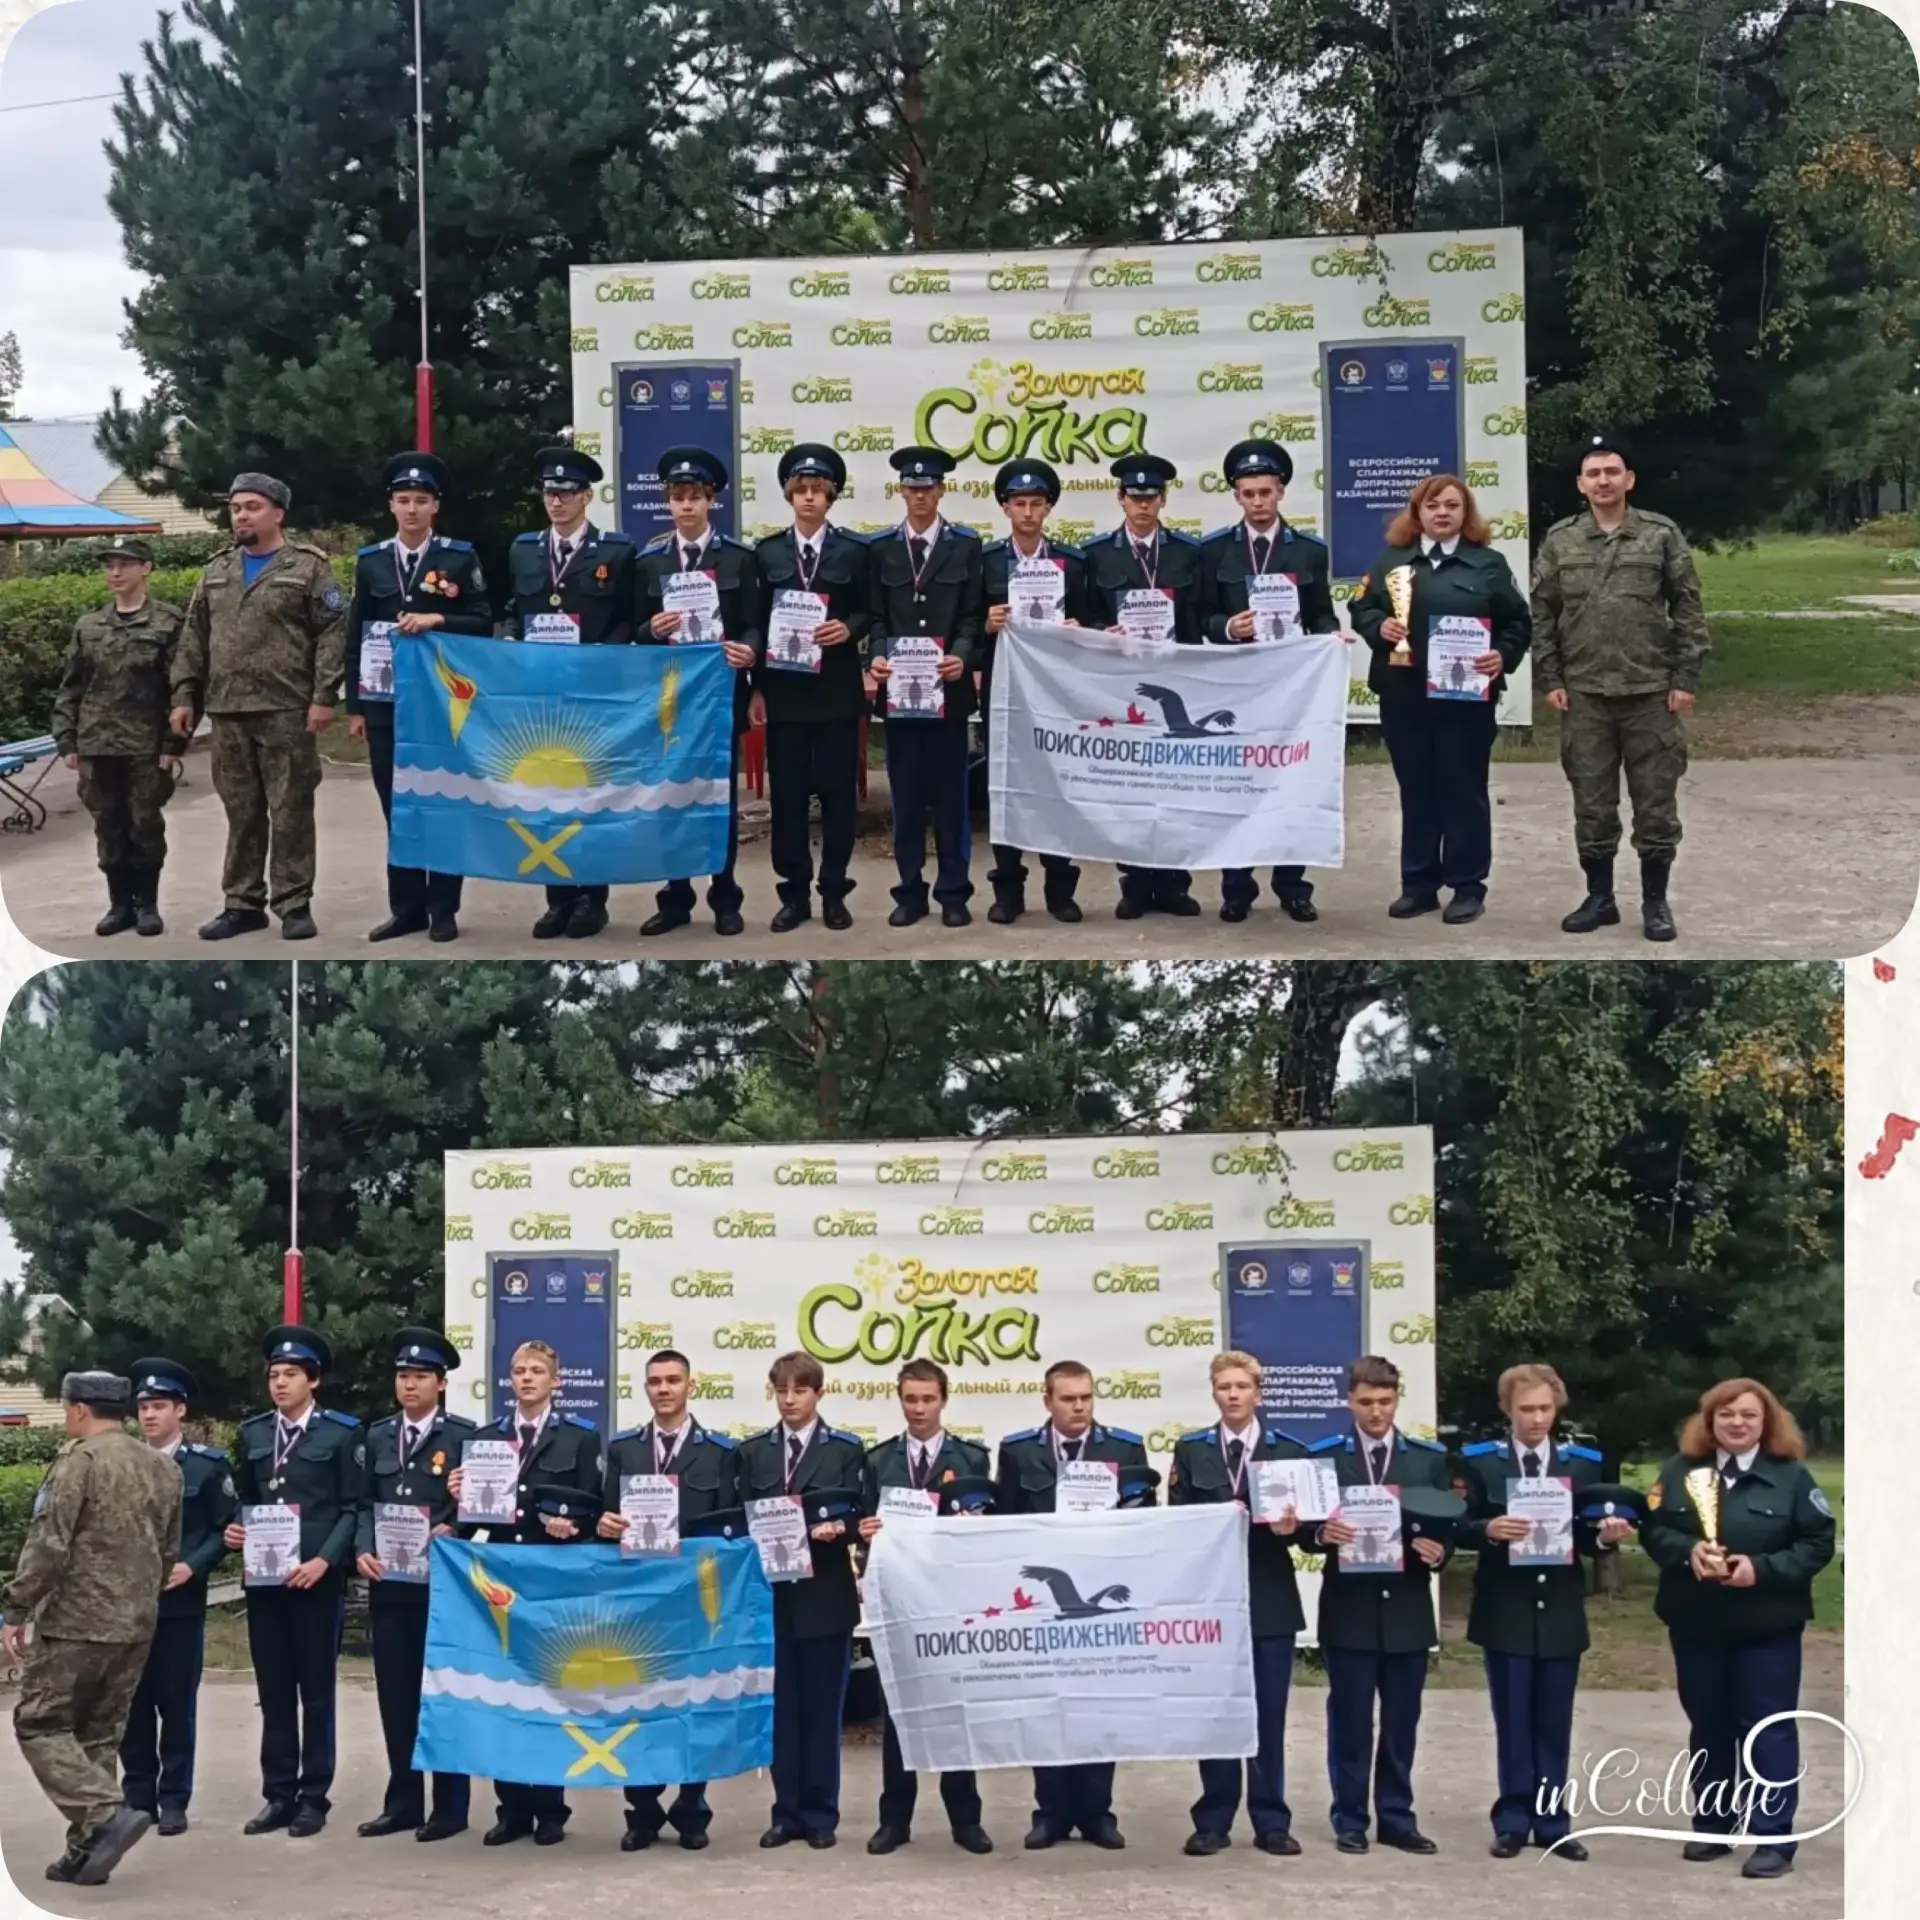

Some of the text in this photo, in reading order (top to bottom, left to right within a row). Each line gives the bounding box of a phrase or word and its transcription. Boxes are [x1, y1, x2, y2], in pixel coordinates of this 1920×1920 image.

[1196, 260, 1262, 282] Сопка
[1428, 250, 1496, 272] Сопка
[889, 274, 951, 294] Сопка
[987, 270, 1049, 291] Сопка
[1089, 265, 1153, 287] Сопка
[595, 281, 655, 302] Сопка
[691, 279, 751, 300] Сопка
[790, 277, 850, 299] Сопка
[1135, 315, 1199, 337] Сопка
[1248, 310, 1314, 331] Сопка
[1363, 306, 1430, 328] Сопка
[634, 329, 694, 350] Сопка
[732, 327, 792, 348] Сопка
[831, 325, 892, 346] Сопка
[928, 323, 990, 343] Сопка
[1029, 319, 1092, 340] Сопка
[1008, 361, 1145, 406] Золотая
[1197, 370, 1263, 393] Сопка
[791, 382, 852, 404] Сопка
[915, 387, 1147, 464] Сопка
[1250, 420, 1315, 442] Сопка
[833, 431, 894, 452] Сопка
[1349, 457, 1439, 468] ВСЕРОССИЙСКАЯ
[1356, 468, 1432, 478] СПАРТАКИАДА
[1013, 570, 1059, 579] ДИПЛОМ
[666, 582, 712, 593] ДИПЛОМ
[1252, 585, 1293, 594] ДИПЛОМ
[778, 601, 822, 612] ДИПЛОМ
[1122, 600, 1168, 610] ДИПЛОМ
[530, 624, 574, 635] ДИПЛОМ
[1436, 628, 1485, 638] ДИПЛОМ
[892, 649, 939, 657] ДИПЛОМ
[981, 1159, 1047, 1182] Сопка
[1093, 1155, 1159, 1178] Сопка
[1333, 1149, 1403, 1172] Сопка
[471, 1167, 532, 1190] Сопка
[569, 1165, 631, 1188] Сопка
[671, 1165, 733, 1187] Сопка
[774, 1164, 837, 1186] Сопка
[876, 1162, 940, 1184] Сопка
[713, 1217, 776, 1239] Сопка
[814, 1215, 877, 1237] Сопка
[919, 1213, 983, 1235] Сопка
[1028, 1211, 1094, 1233] Сопка
[1145, 1208, 1213, 1231] Сопка
[1264, 1206, 1335, 1228] Сопка
[510, 1218, 571, 1240] Сопка
[611, 1217, 673, 1240] Сопка
[671, 1277, 733, 1298] Сопка
[895, 1259, 1038, 1304] Золотая
[1093, 1270, 1160, 1293] Сопка
[798, 1283, 1041, 1365] Сопка
[713, 1328, 776, 1350] Сопка
[1145, 1324, 1214, 1347] Сопка
[1095, 1377, 1161, 1399] Сопка
[1262, 1386, 1338, 1396] ОПРИЗЫВНОЙ
[467, 1452, 514, 1460] ДИПЛОМ
[1063, 1473, 1112, 1482] ДИПЛОМ
[628, 1487, 673, 1496] ДИПЛОМ
[249, 1516, 295, 1525] ДИПЛОМ
[380, 1515, 425, 1524] ДИПЛОМ
[752, 1508, 798, 1519] ДИПЛОМ
[915, 1618, 1222, 1658] ПОИСКОВОЕДВИЖЕНИЕРОССИИ
